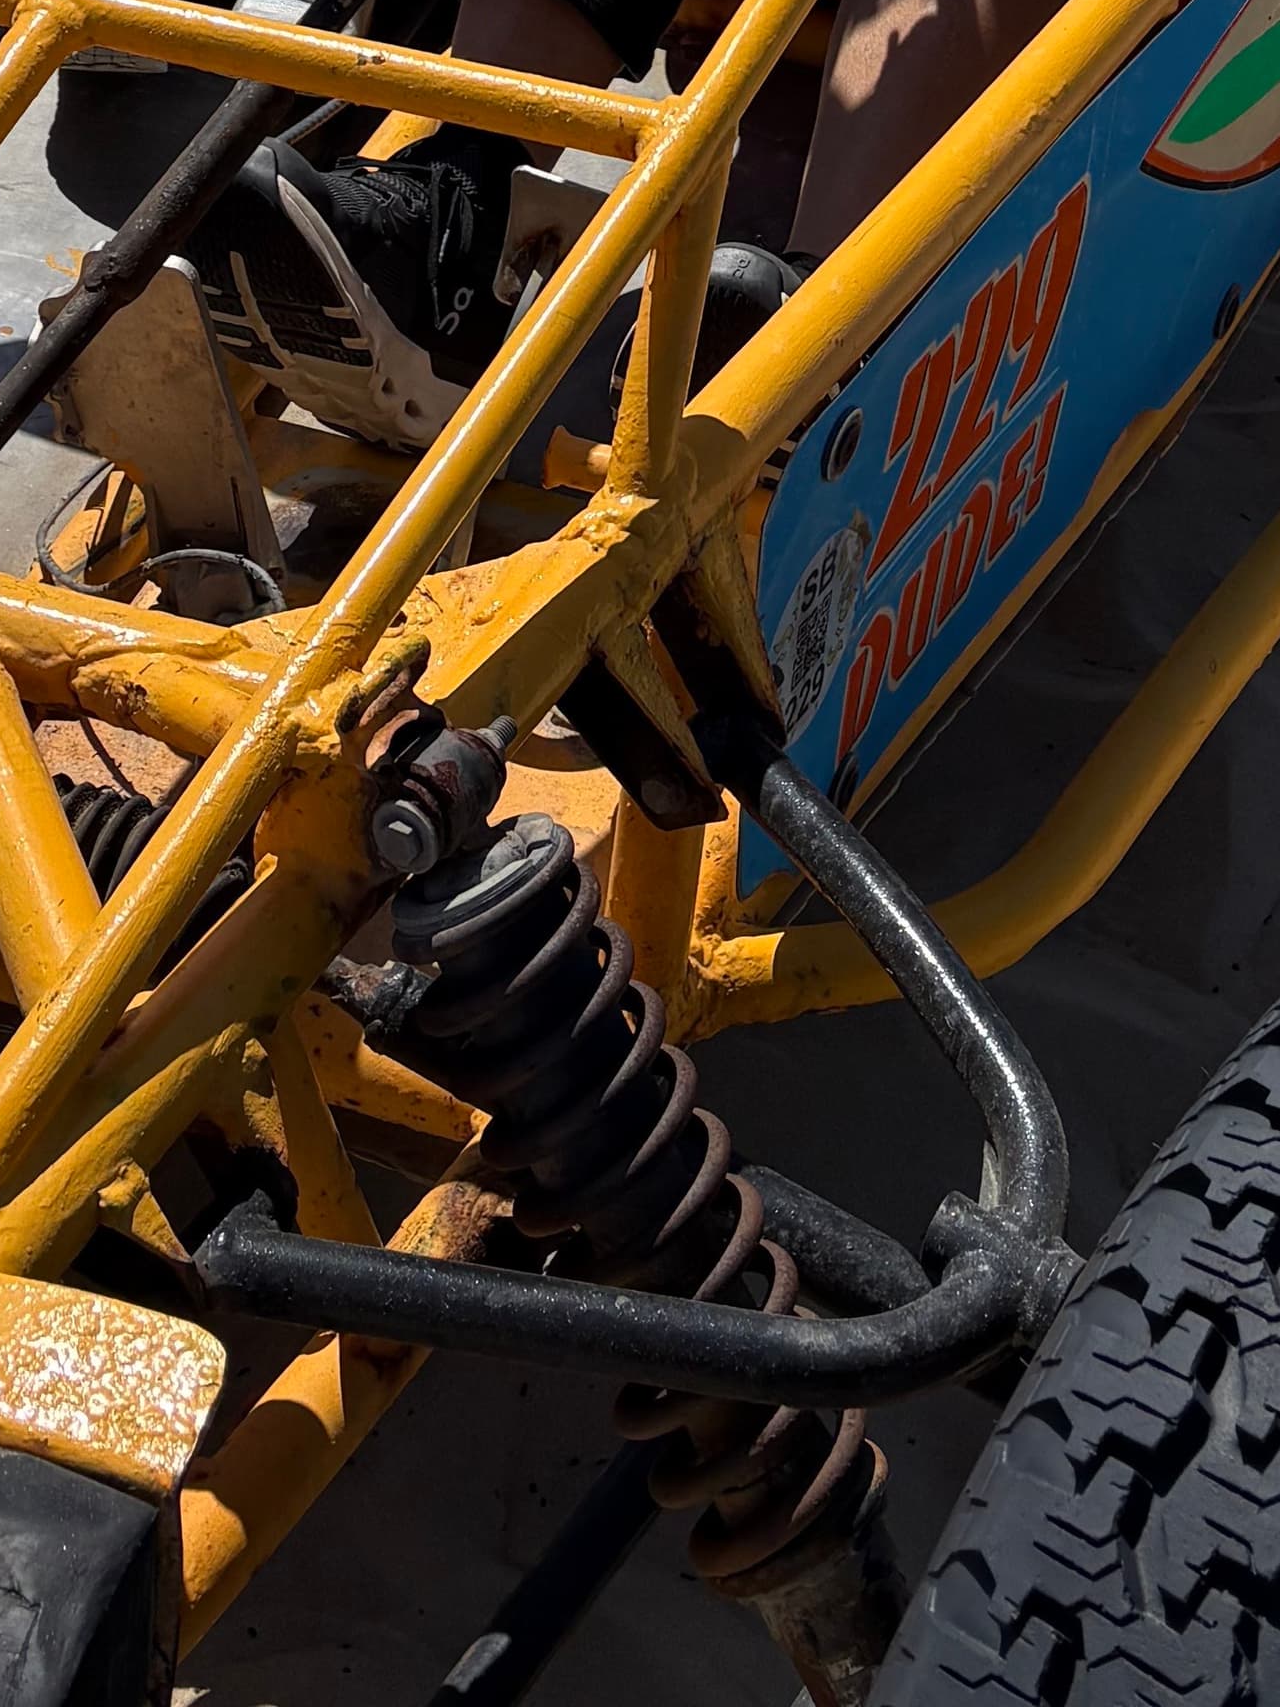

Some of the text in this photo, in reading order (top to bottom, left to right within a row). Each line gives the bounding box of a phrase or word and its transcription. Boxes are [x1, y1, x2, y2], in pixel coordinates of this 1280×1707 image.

[866, 175, 1091, 587] 229
[801, 550, 837, 613] SB
[834, 382, 1069, 762] DUDE!
[785, 662, 826, 734] 229
